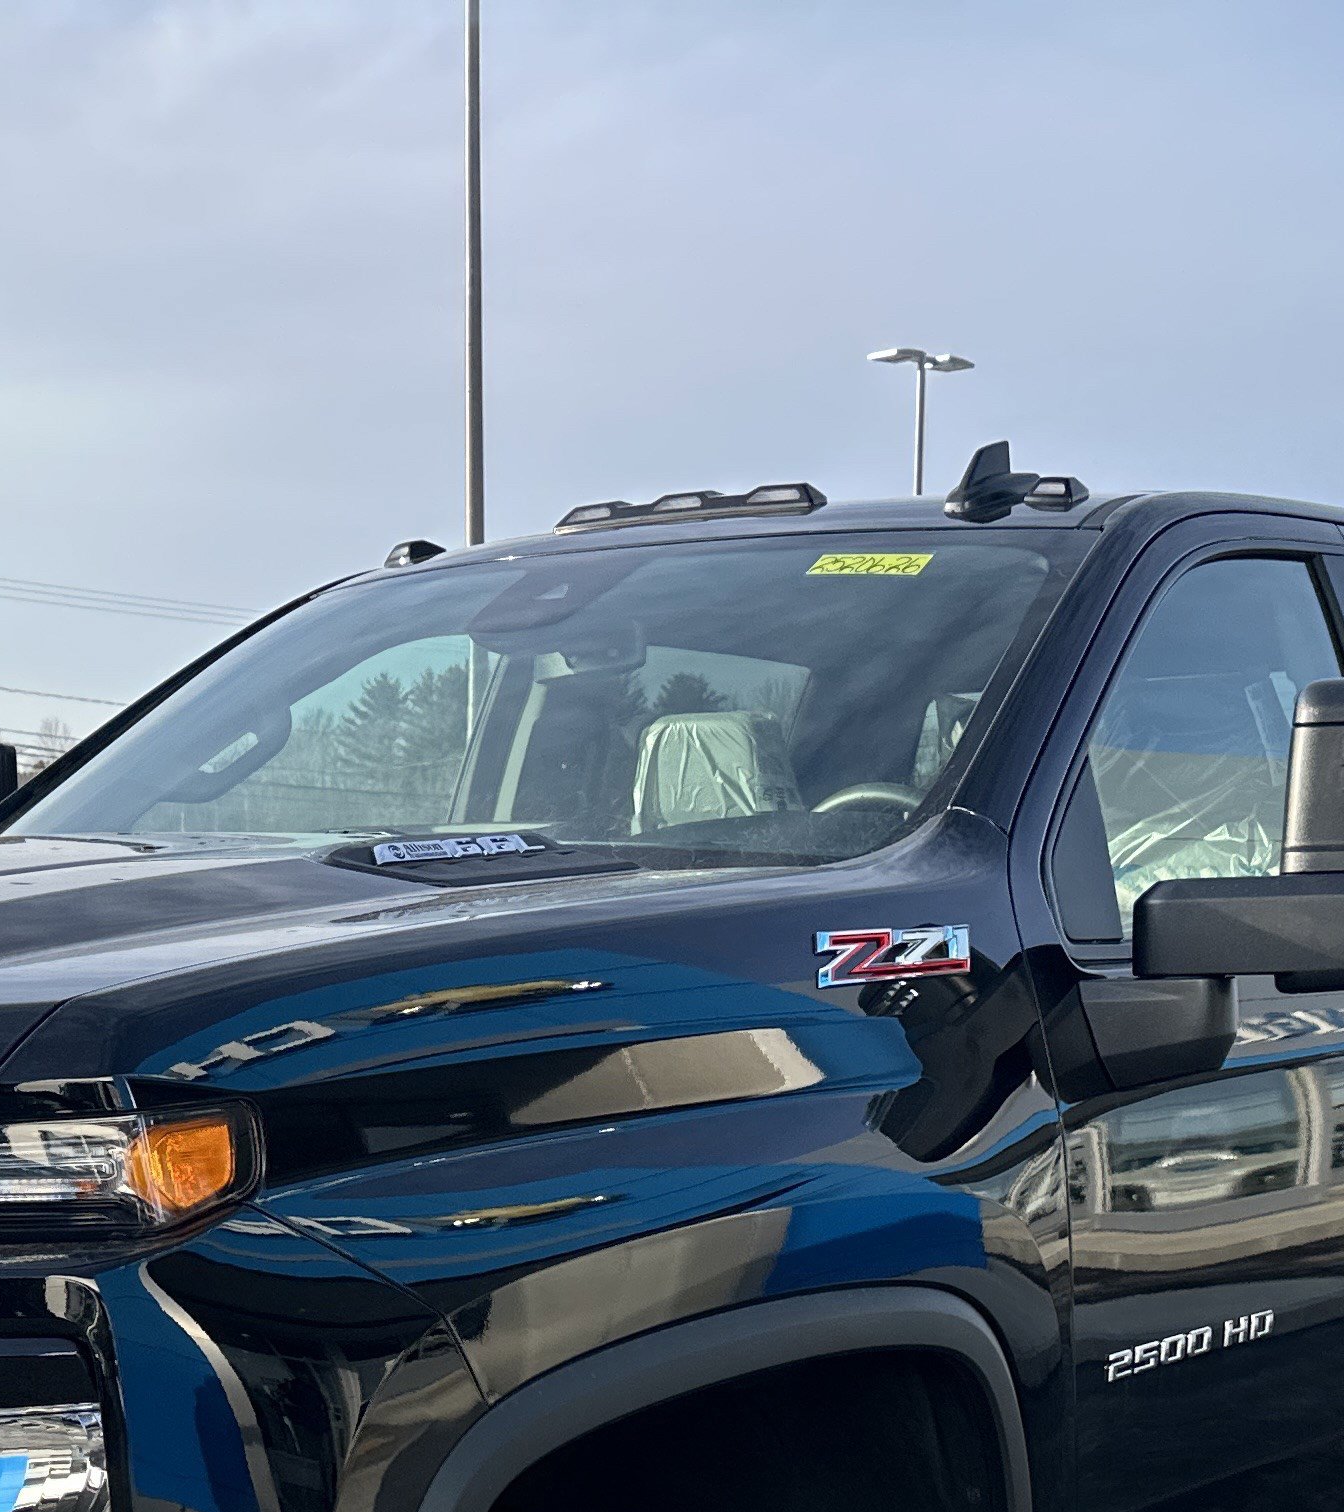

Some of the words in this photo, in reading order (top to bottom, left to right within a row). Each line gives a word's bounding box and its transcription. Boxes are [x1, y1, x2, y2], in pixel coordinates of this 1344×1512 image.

[403, 842, 444, 853] Allison
[814, 923, 971, 989] Z71
[1105, 1326, 1213, 1383] 2500
[1223, 1309, 1275, 1347] HD
